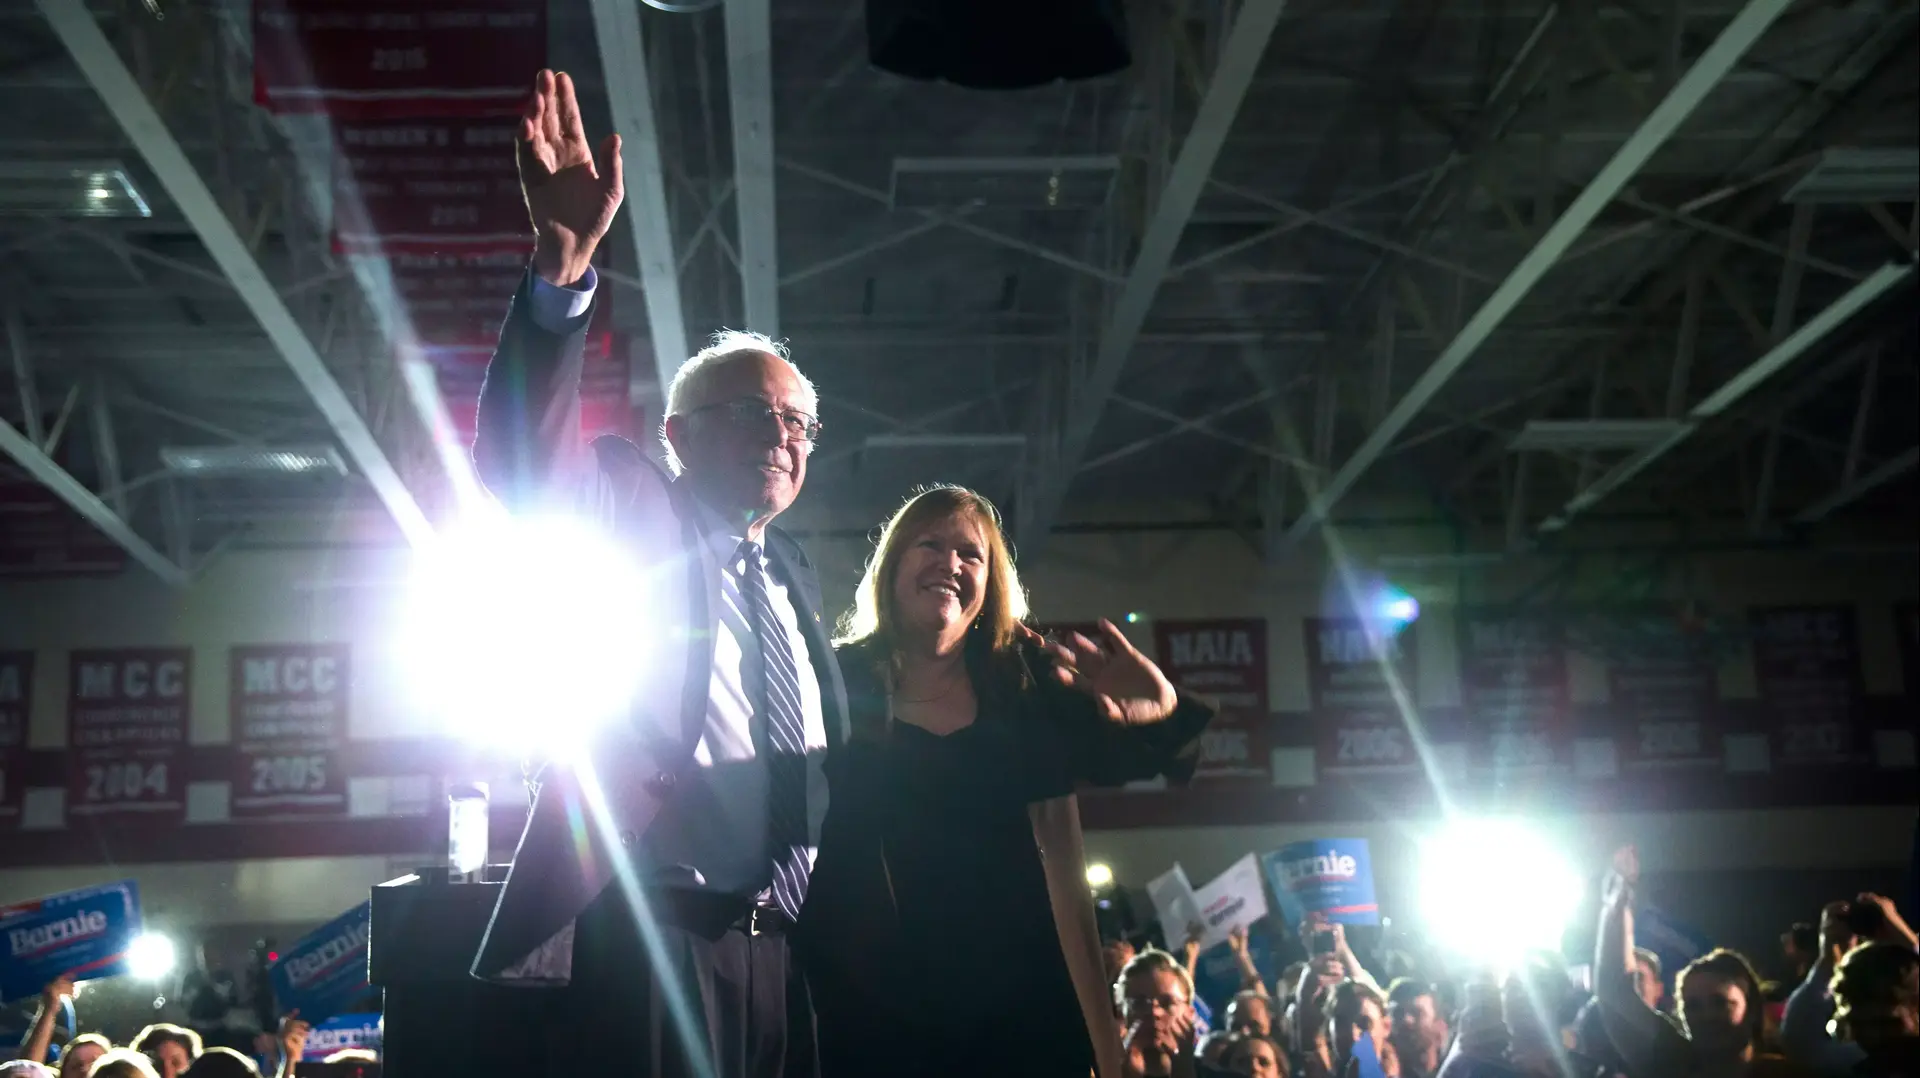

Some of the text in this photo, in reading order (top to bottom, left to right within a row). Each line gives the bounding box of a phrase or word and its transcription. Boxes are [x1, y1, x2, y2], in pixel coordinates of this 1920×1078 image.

[1168, 629, 1253, 667] NAIA
[80, 660, 185, 699] MCC
[243, 656, 337, 694] MCC
[85, 762, 168, 800] 2004
[252, 756, 327, 792] 2005
[8, 909, 108, 956] Bernie
